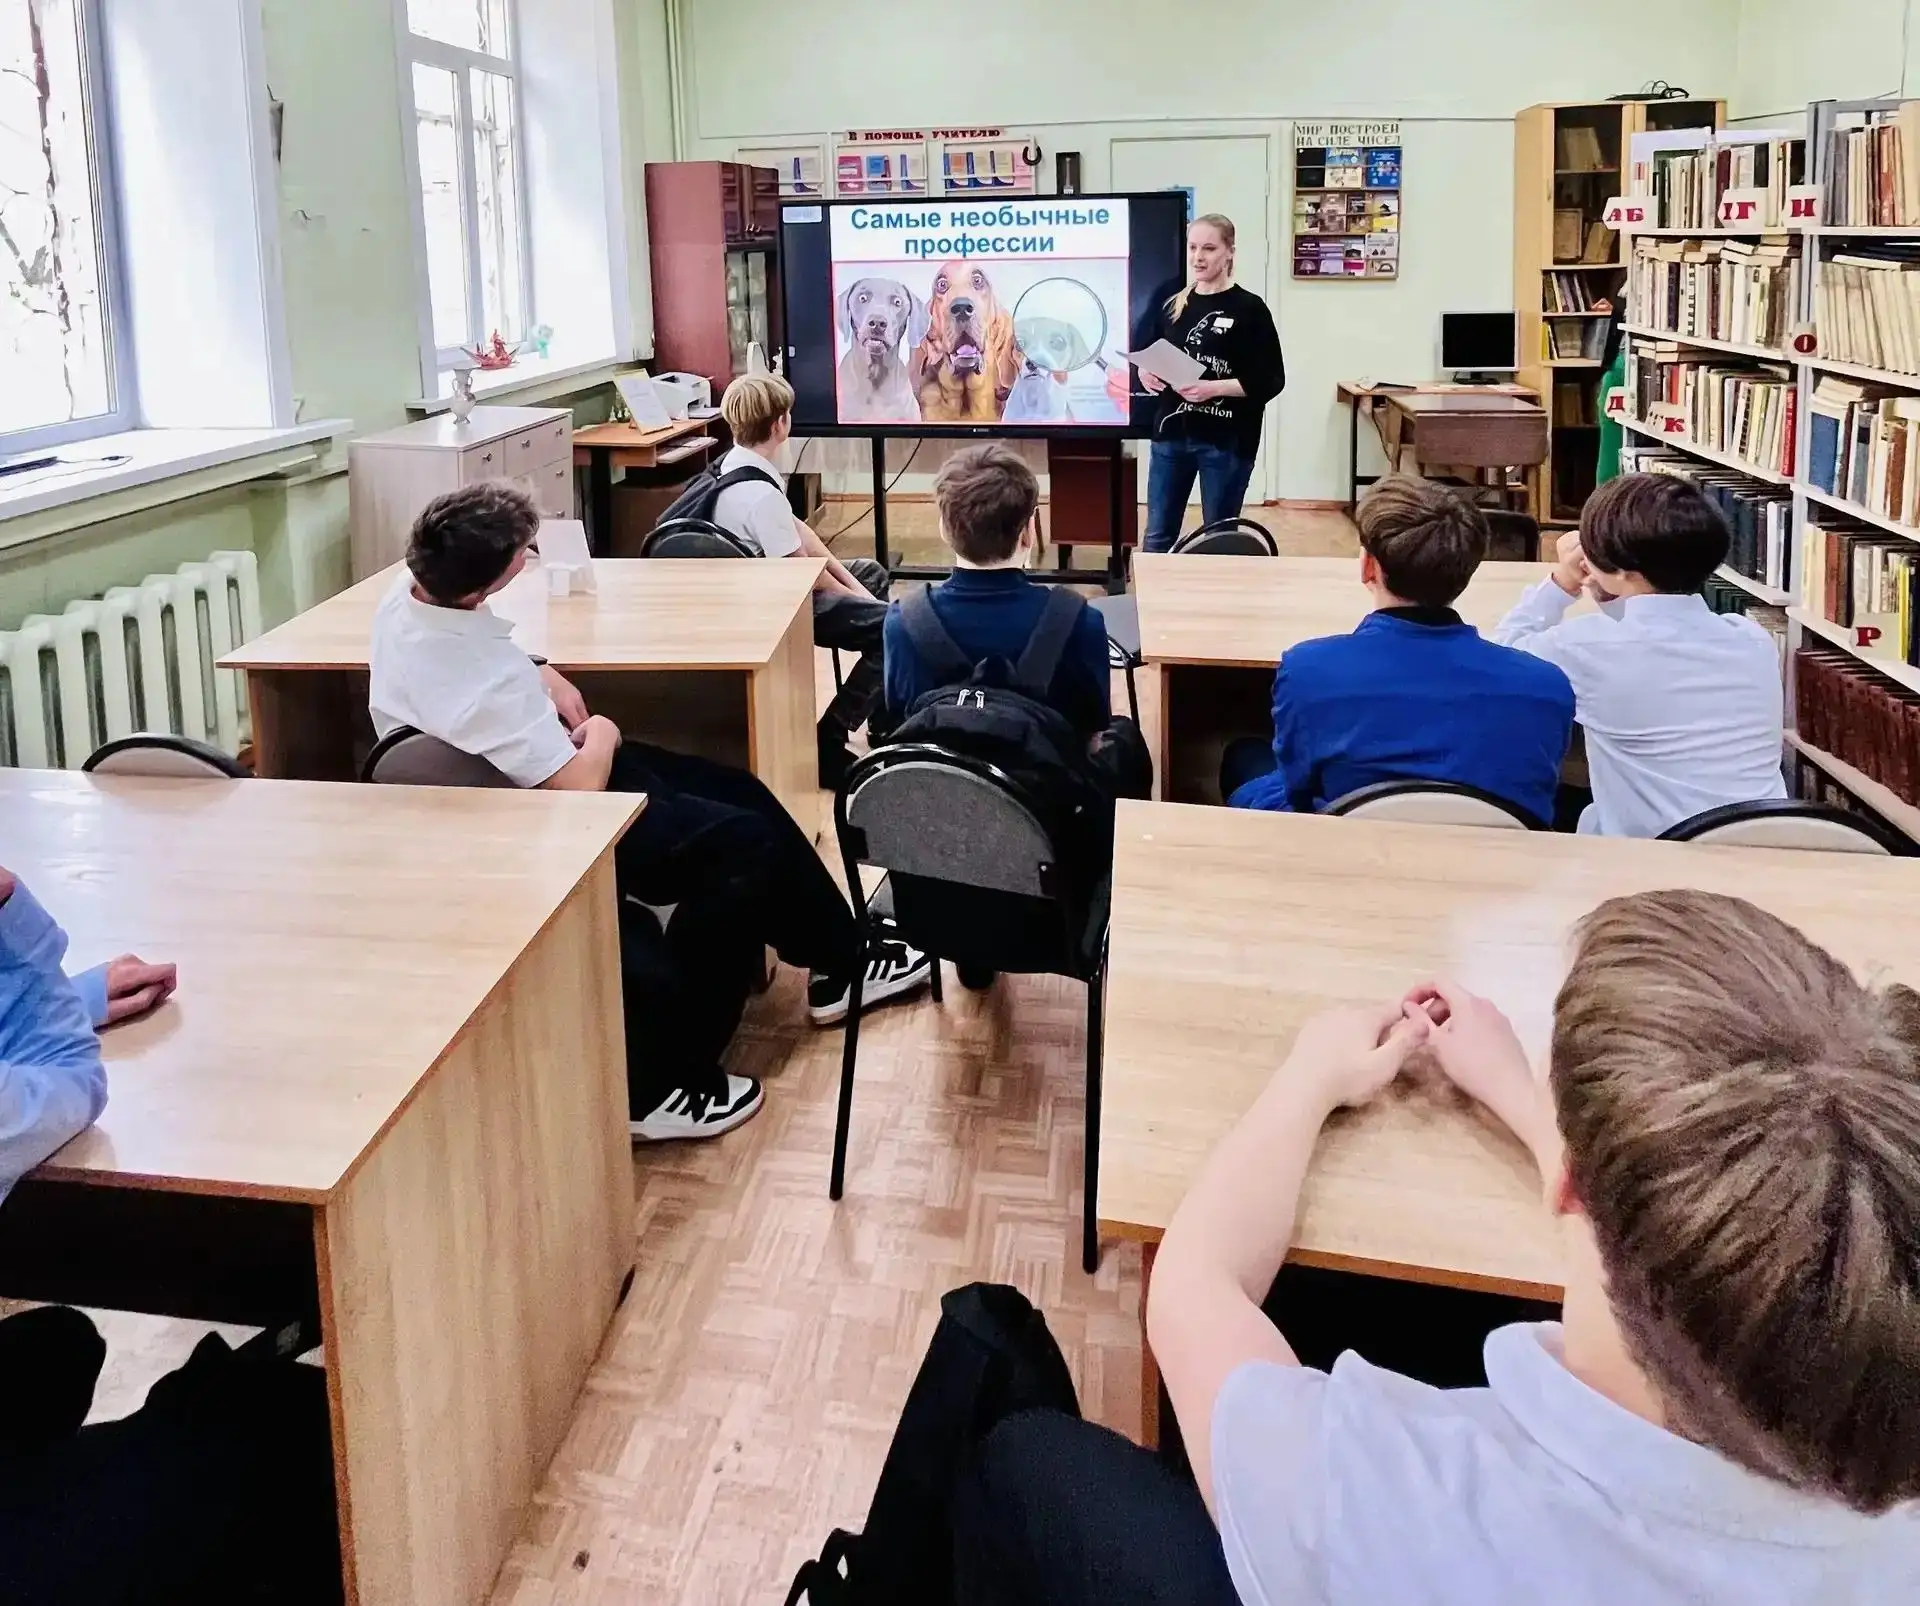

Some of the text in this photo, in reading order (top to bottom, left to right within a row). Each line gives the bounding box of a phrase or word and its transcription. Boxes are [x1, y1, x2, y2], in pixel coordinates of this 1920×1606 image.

[848, 128, 1001, 141] В ПОМОЩЬ УЧИТЕЛЮ
[1296, 123, 1399, 135] МИР ПОСТРОЕН
[1297, 135, 1400, 146] НА СИЛЕ ЧИСЕЛ
[851, 205, 1110, 230] Самые необычные
[905, 233, 1055, 258] профессии
[1607, 396, 1626, 413] Д
